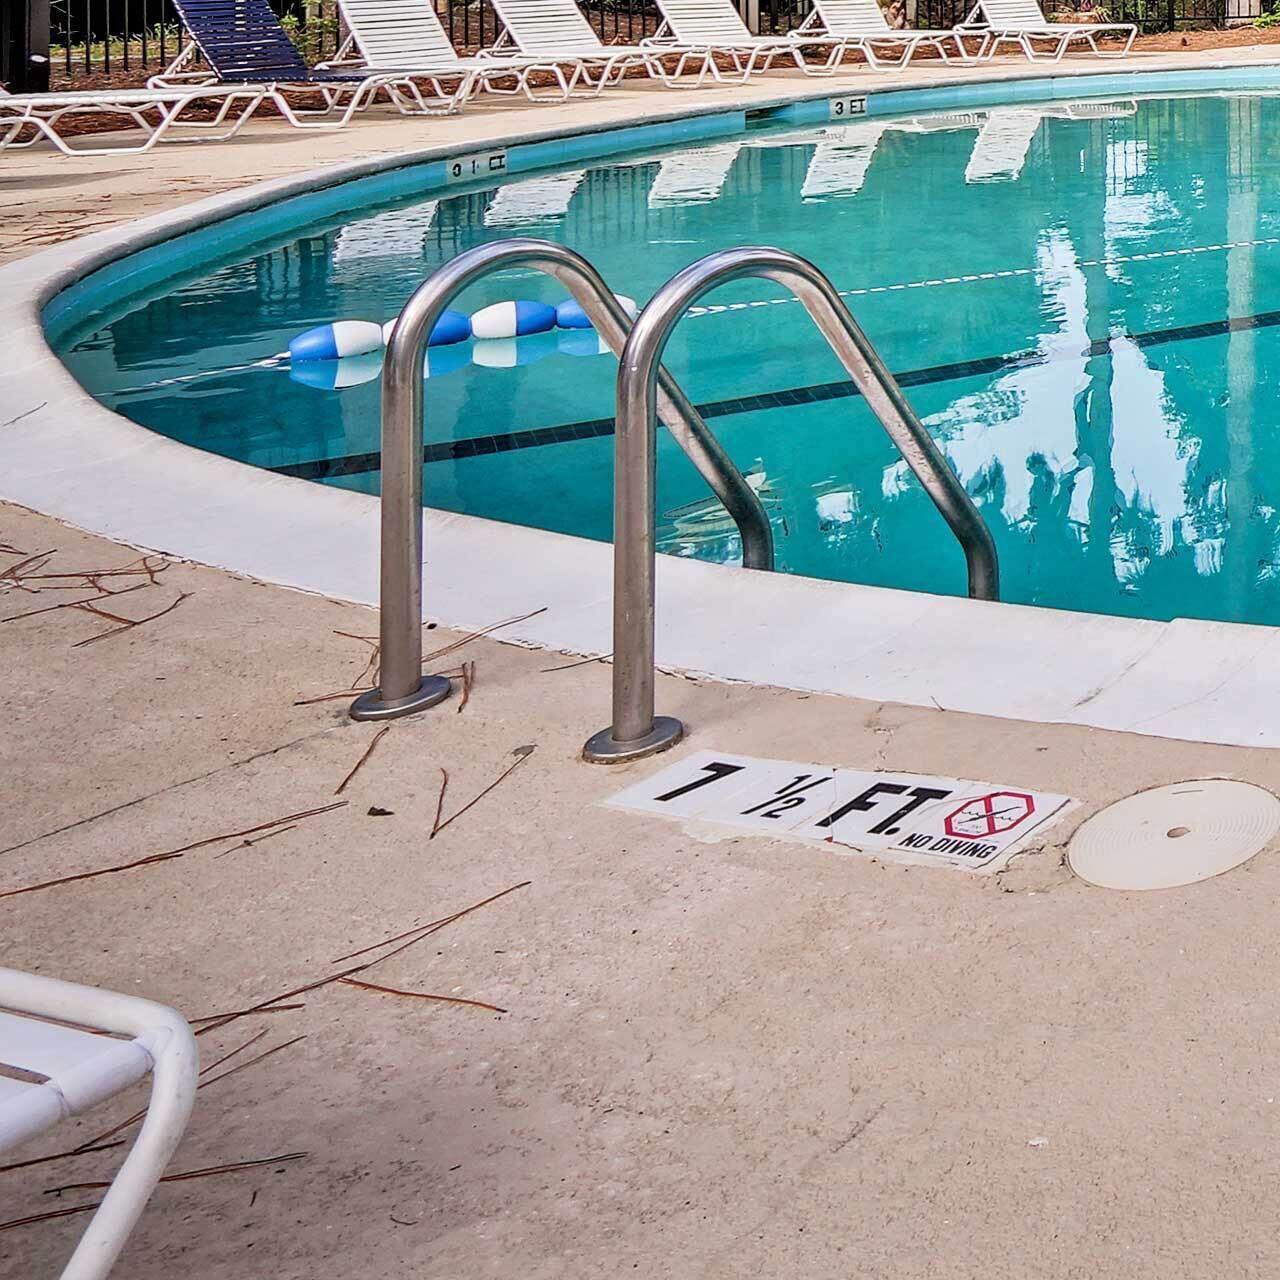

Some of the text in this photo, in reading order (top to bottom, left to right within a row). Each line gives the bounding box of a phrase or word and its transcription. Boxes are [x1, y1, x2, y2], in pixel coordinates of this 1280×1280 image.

[835, 101, 844, 116] 3
[653, 761, 746, 802] 7
[814, 782, 954, 836] FT.
[898, 832, 998, 859] NO DIVING
